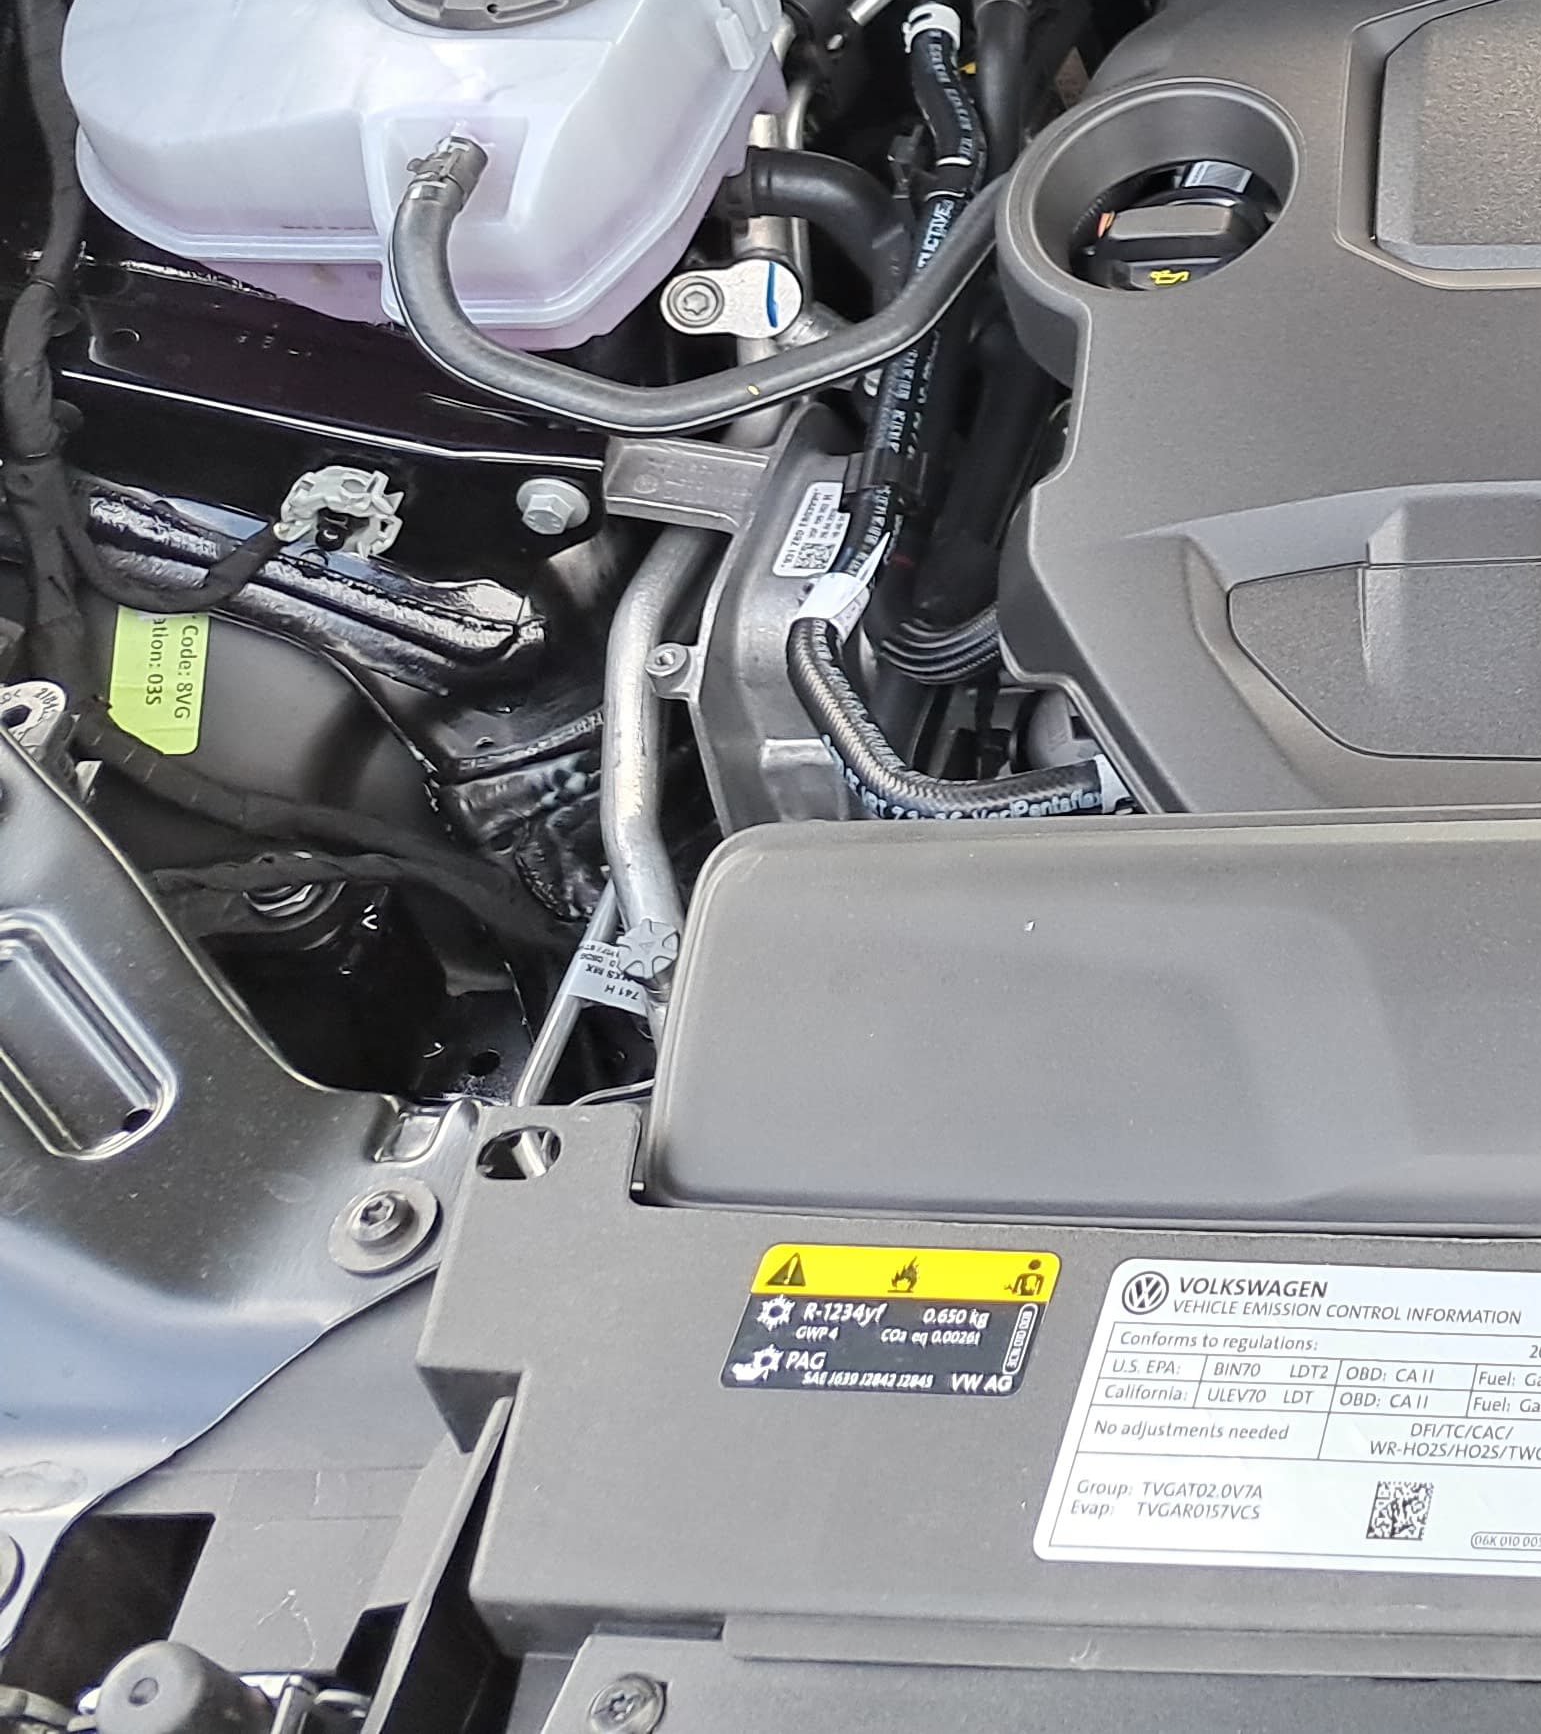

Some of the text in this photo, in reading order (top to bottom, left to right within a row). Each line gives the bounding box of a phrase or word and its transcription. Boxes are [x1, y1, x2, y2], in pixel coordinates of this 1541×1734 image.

[174, 625, 199, 719] Code: 8VG
[145, 674, 164, 705] 03S
[604, 984, 639, 1000] 741 H
[1180, 1277, 1328, 1298] VOLKSWAGEN
[803, 1302, 888, 1328] R-1234yf
[922, 1308, 990, 1330] 0.650 kg
[1174, 1300, 1522, 1325] VEHICLE EMISSION CONTROL INFORMATION
[795, 1325, 829, 1342] GWP
[911, 1332, 928, 1348] eq
[1120, 1331, 1319, 1353] Conforms to regulations:
[785, 1351, 827, 1370] PAG
[1112, 1359, 1181, 1375] U.S. EPA:
[802, 1371, 828, 1385] SAE
[1214, 1362, 1328, 1379] BIN70 LDT2
[1346, 1366, 1434, 1383] OBD: CA II
[1479, 1371, 1515, 1386] Fuel:
[951, 1373, 1012, 1392] VW AG
[1105, 1384, 1188, 1401] California:
[1208, 1388, 1314, 1404] ULEV70 LDT
[1340, 1392, 1428, 1409] OBD: CA II
[1473, 1397, 1511, 1412] Fuel:
[1094, 1420, 1290, 1440] No adjustments needed
[1410, 1423, 1514, 1440] DFI/TC/CAC/
[1077, 1479, 1262, 1499] Group: TVGAT02.0V7A
[1071, 1500, 1260, 1520] Evap: TVGAR0157VCS
